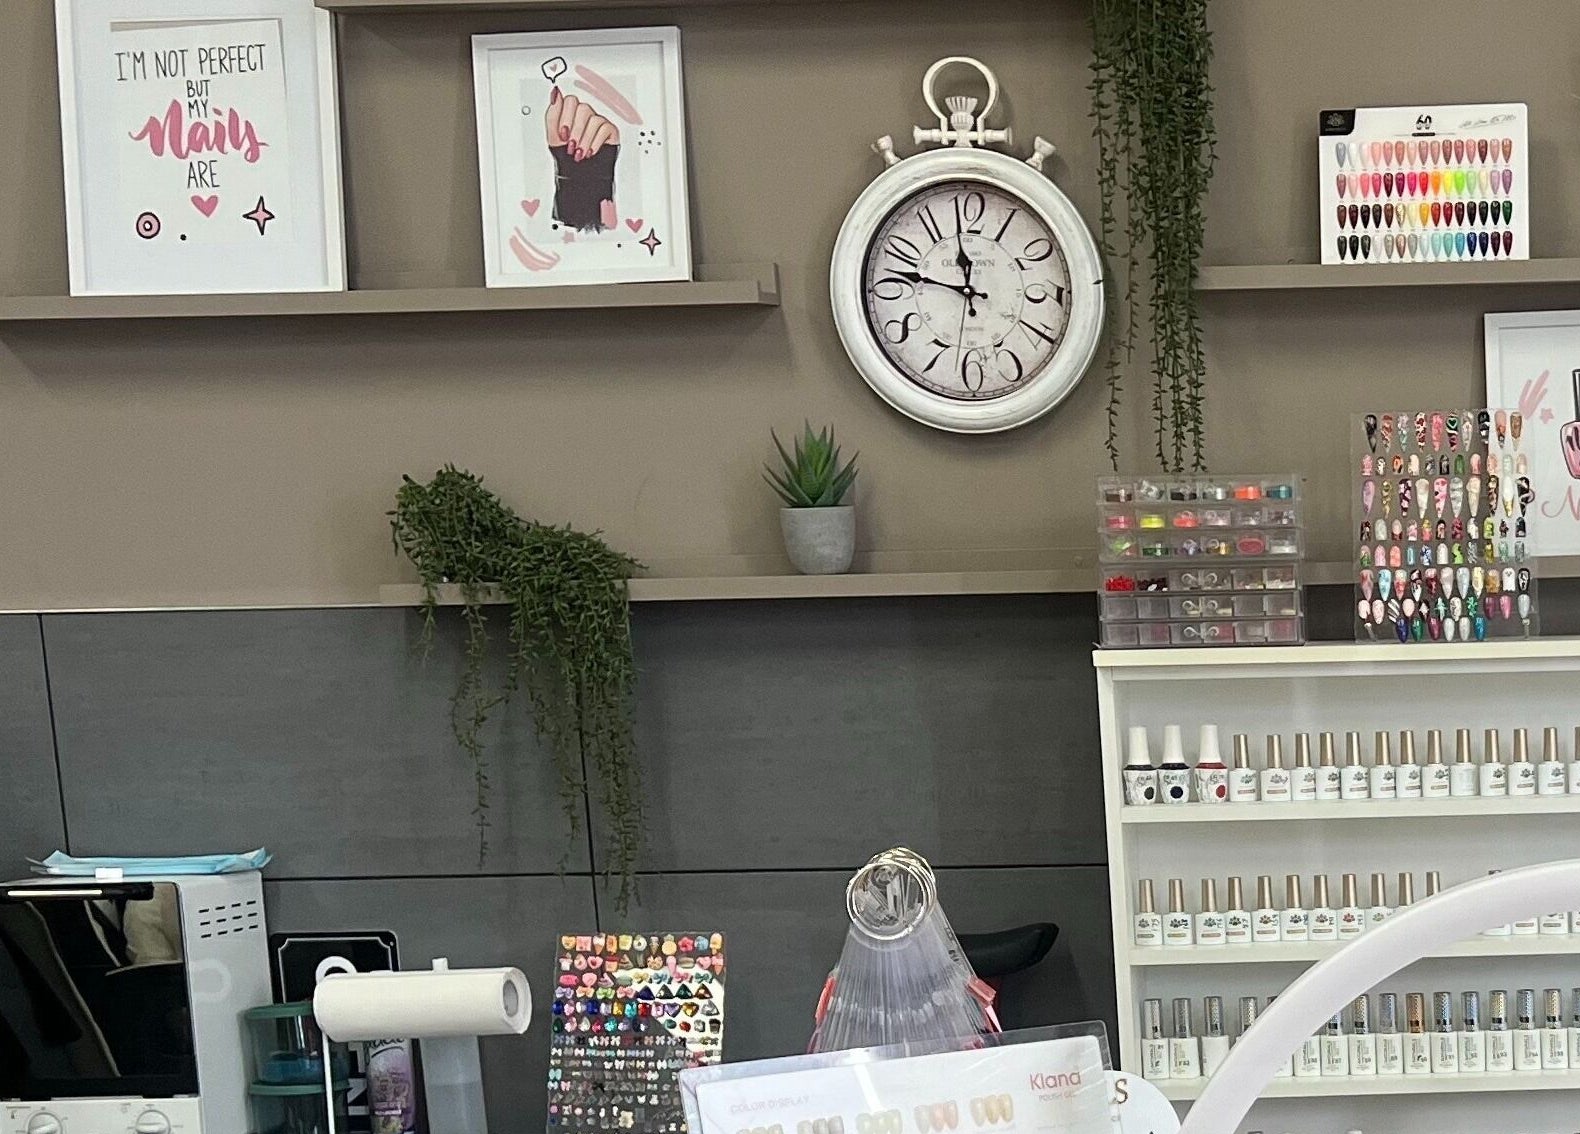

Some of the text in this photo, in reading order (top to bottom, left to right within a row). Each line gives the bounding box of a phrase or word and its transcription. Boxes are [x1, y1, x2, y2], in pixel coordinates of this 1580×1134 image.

[114, 44, 266, 81] I'M NOT PERFECT
[186, 79, 211, 98] BUT
[187, 99, 209, 118] MY
[128, 98, 269, 163] Nails
[187, 159, 220, 189] ARE
[916, 204, 945, 243] 11
[947, 191, 986, 235] 12
[994, 207, 1022, 243] 1
[882, 233, 923, 269] 10
[1014, 237, 1054, 272] 2
[1023, 278, 1064, 307] 3
[883, 311, 923, 345] 8
[1018, 319, 1056, 352] 4
[922, 337, 951, 374] 7
[961, 348, 984, 393] 6
[991, 339, 1024, 383] 5
